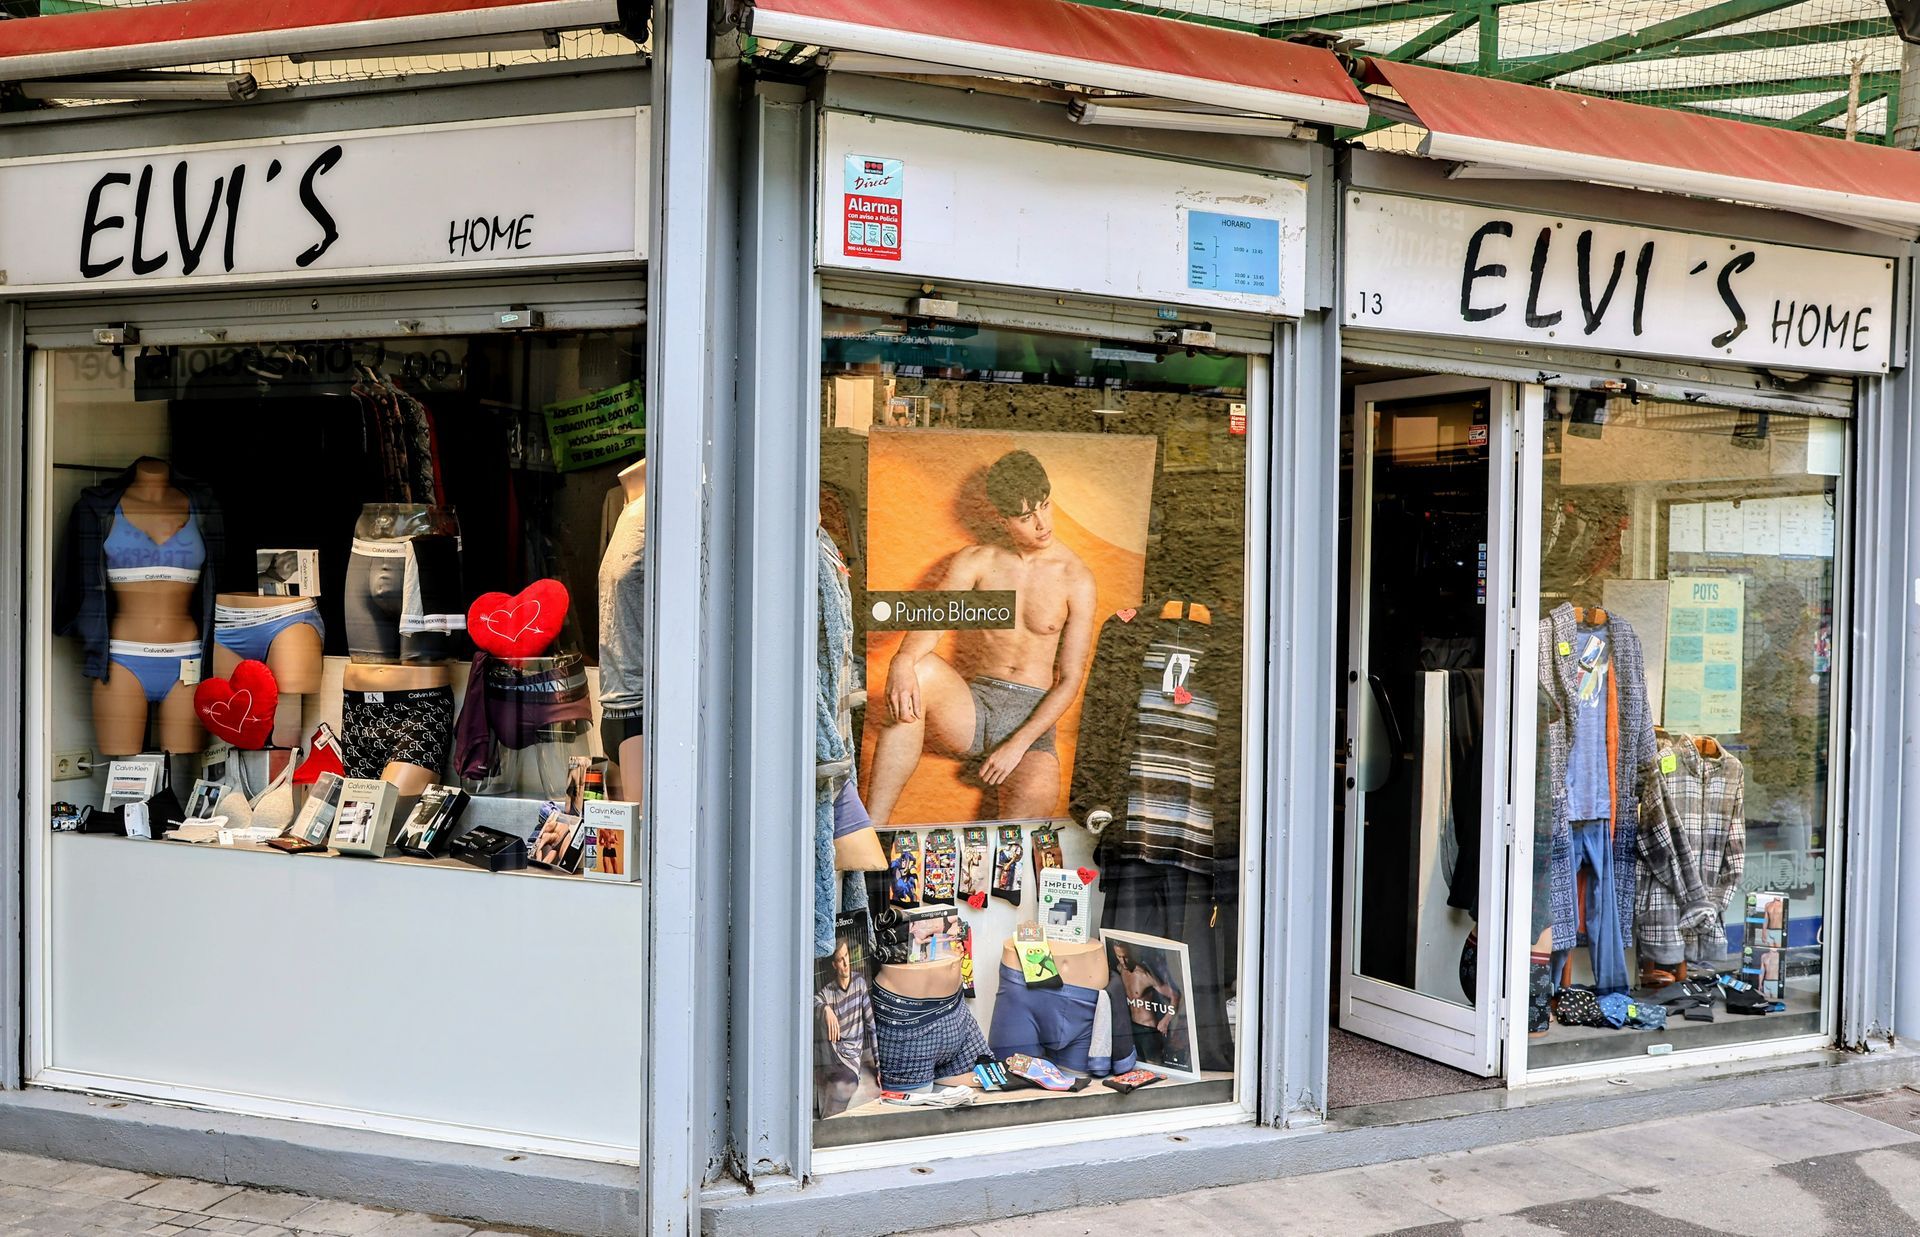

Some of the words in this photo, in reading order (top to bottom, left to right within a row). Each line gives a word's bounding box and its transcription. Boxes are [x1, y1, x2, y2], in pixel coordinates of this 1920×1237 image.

[854, 176, 894, 190] Direct
[79, 144, 343, 279] ELVI'S
[448, 213, 535, 258] HOME
[848, 198, 898, 215] Alarma
[1221, 220, 1252, 229] HORARIO
[1358, 291, 1383, 316] 13
[1771, 299, 1873, 352] HOME
[1692, 583, 1720, 600] POTS
[896, 601, 945, 622] Punto
[948, 600, 1010, 622] Blanco
[590, 806, 609, 815] Calvin
[610, 807, 626, 816] Klein
[934, 834, 951, 844] JENES
[966, 830, 985, 840] JENES
[1002, 830, 1019, 839] JENES
[1038, 832, 1054, 843] JENES
[898, 836, 915, 846] JENES
[1044, 880, 1083, 891] IMPETUS
[1020, 927, 1040, 938] JENES
[1127, 996, 1176, 1016] MPETUS
